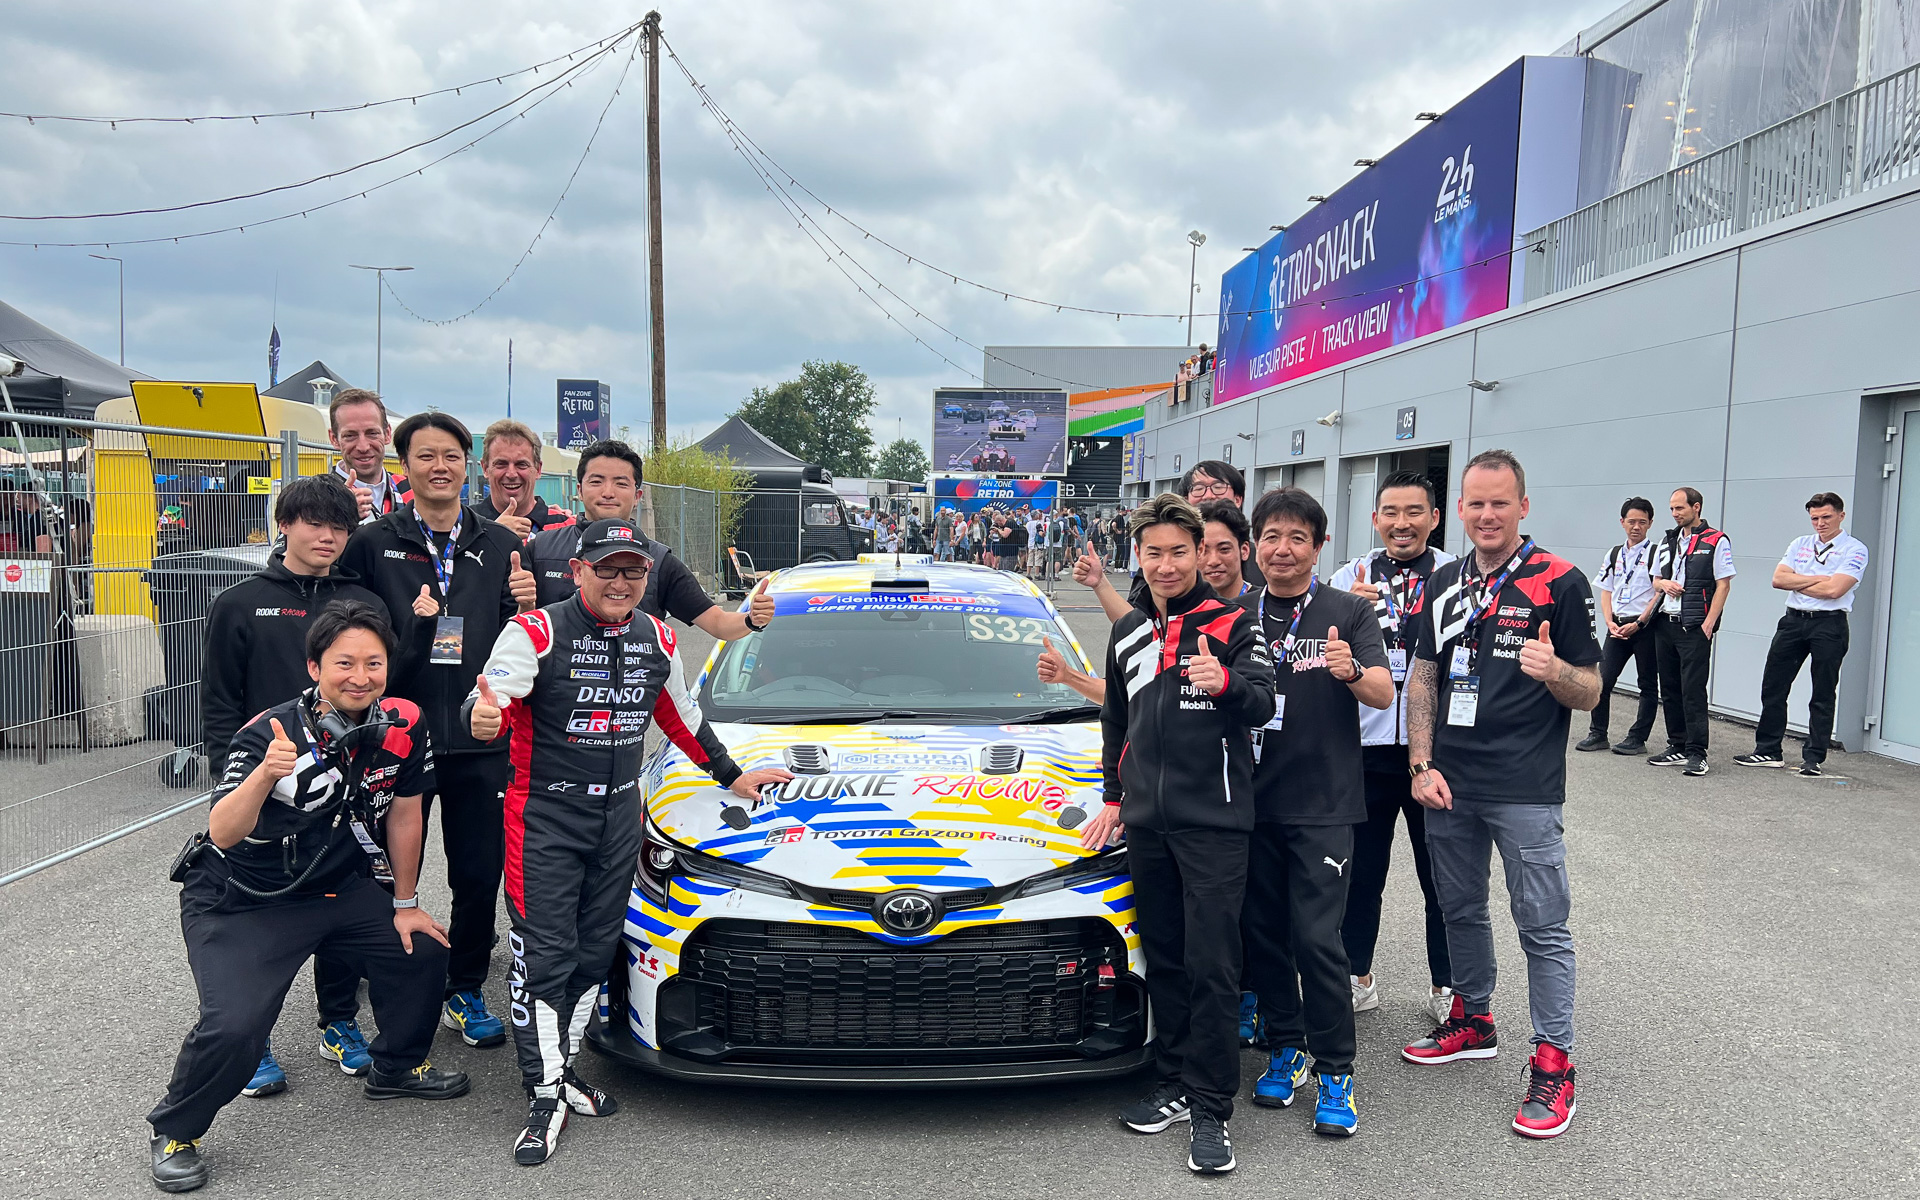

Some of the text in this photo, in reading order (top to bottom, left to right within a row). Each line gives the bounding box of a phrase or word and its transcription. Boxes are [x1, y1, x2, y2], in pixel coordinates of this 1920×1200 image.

[1434, 194, 1471, 223] LE MANS
[1269, 199, 1379, 331] RETRO SNACK
[1249, 354, 1265, 381] VUE
[1264, 349, 1281, 376] SUR
[1281, 336, 1307, 369] PISTE
[1322, 314, 1357, 354] TRACK
[1358, 300, 1391, 341] VIEW
[562, 397, 594, 415] RETRO
[1403, 411, 1414, 428] 05
[1295, 433, 1303, 447] 04
[993, 480, 1013, 488] ZONE
[977, 489, 1015, 498] RETRO
[607, 527, 632, 538] GR
[383, 549, 407, 560] ROOKIE
[837, 594, 977, 605] idemitsu 1500
[255, 607, 281, 617] ROOKIE
[806, 604, 1000, 614] SUPER ENDURANCE 2022
[968, 614, 1045, 643] S32
[1497, 618, 1530, 629] DENSO
[572, 634, 609, 653] FUJITSU
[1494, 630, 1527, 647] FUJITSU
[623, 642, 644, 653] Mobil
[1492, 648, 1516, 659] Mobil
[570, 653, 609, 665] AISIN
[623, 668, 651, 679] WEC
[576, 686, 645, 704] DENSO
[1179, 700, 1206, 710] Mobil
[567, 714, 610, 732] GR
[567, 734, 644, 747] RACING HYBRID
[750, 774, 1074, 812] ROOKIE RACING
[765, 828, 1047, 848] GR TOYOTA GAZOO Racing
[638, 965, 657, 980] Kawasaki
[1057, 964, 1077, 975] GR
[508, 929, 531, 1028] DENSO
